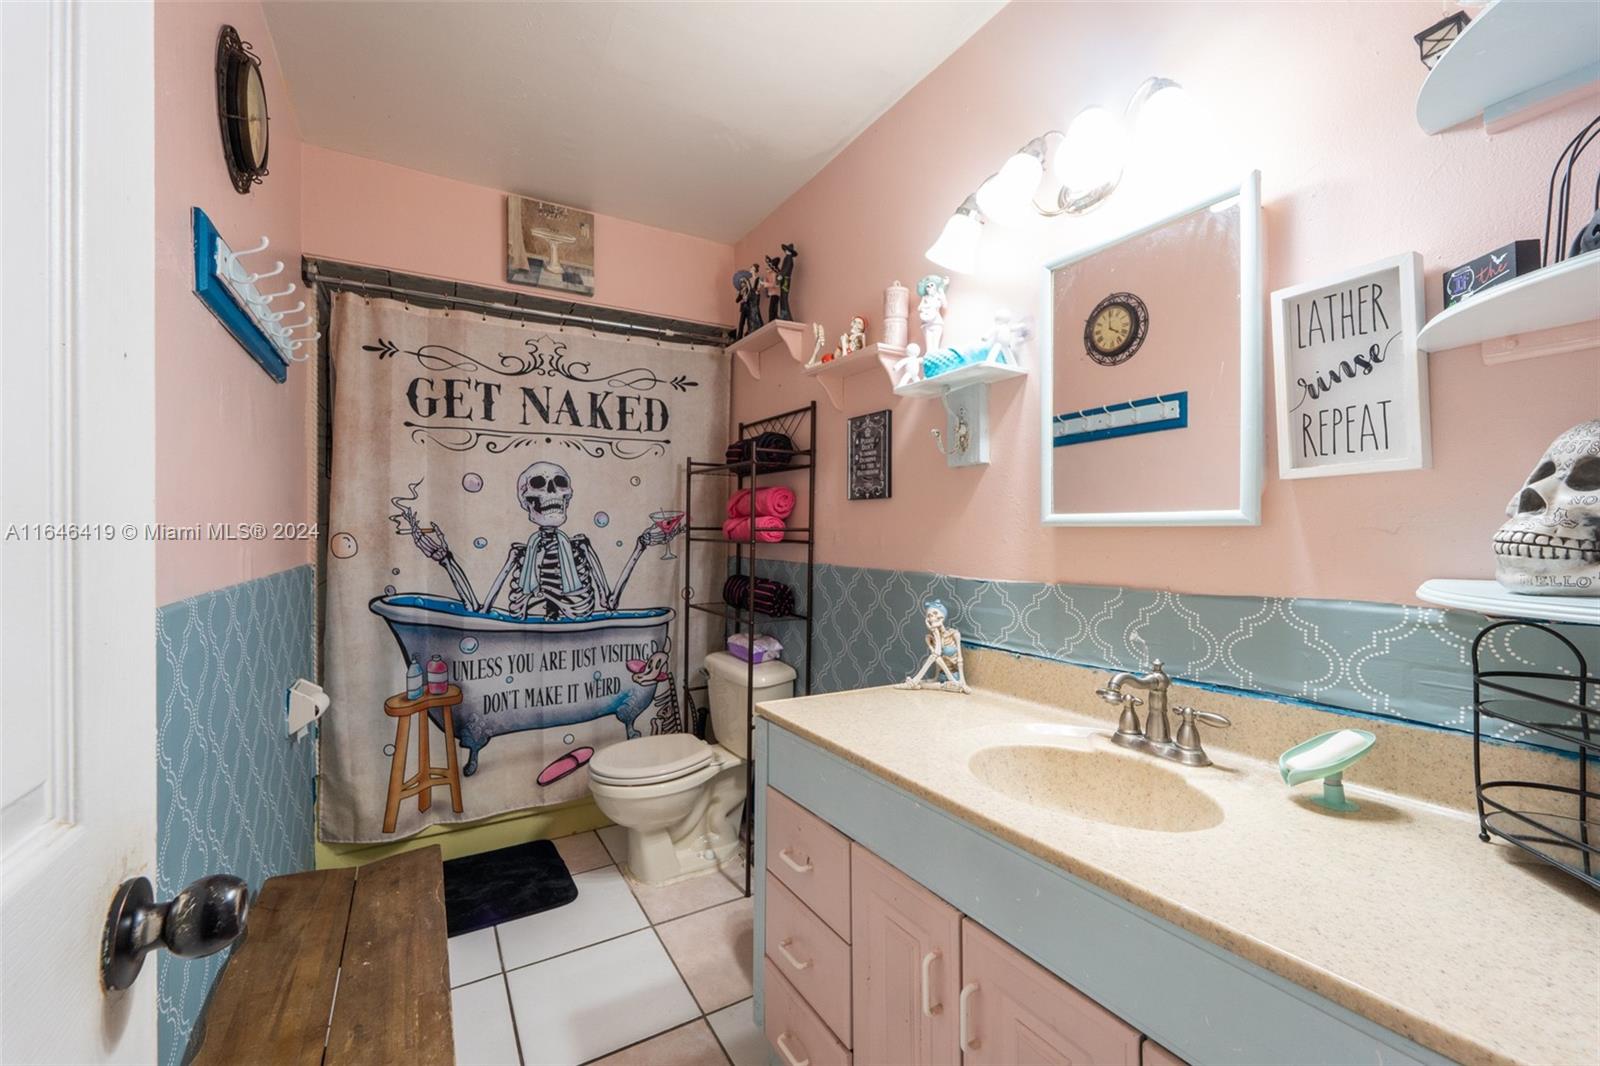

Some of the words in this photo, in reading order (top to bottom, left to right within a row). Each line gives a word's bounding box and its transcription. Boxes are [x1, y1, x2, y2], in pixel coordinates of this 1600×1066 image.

[1475, 259, 1509, 283] the
[1296, 283, 1389, 349] LATHER
[1290, 332, 1401, 412] rinse
[406, 376, 501, 422] GET
[519, 385, 670, 433] NAKED
[1302, 400, 1392, 458] REPEAT
[1568, 495, 1599, 505] NO
[452, 656, 504, 682] UNLESS
[508, 652, 535, 675] YOU
[540, 650, 567, 673] ARE
[571, 646, 597, 670] JUST
[599, 642, 649, 664] VISITING
[483, 689, 520, 716] DON'T
[524, 686, 563, 708] MAKE
[567, 683, 579, 703] IT
[584, 676, 622, 699] WEIRD
